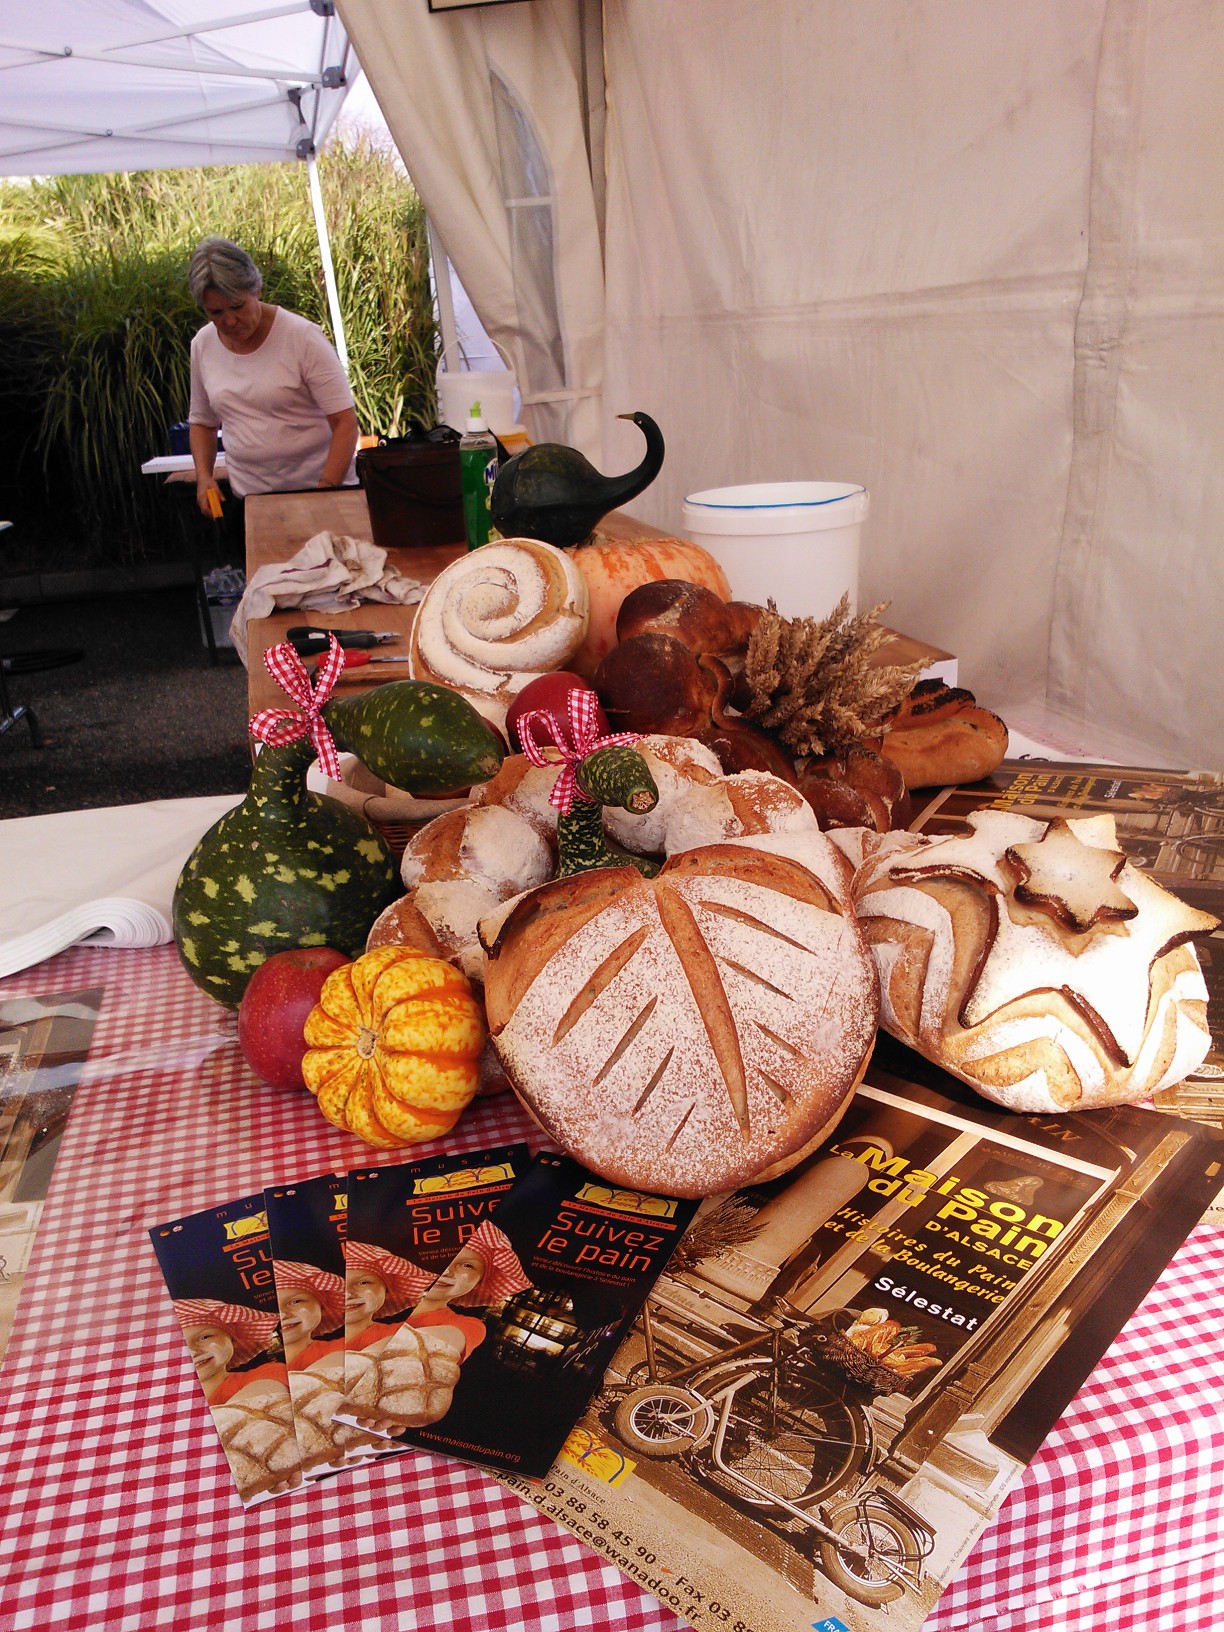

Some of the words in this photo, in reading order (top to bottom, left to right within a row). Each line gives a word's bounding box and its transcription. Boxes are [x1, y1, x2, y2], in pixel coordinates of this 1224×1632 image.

[987, 774, 1031, 809] Maison
[1025, 774, 1051, 792] Pain
[828, 1143, 855, 1160] La
[854, 1146, 1065, 1239] Maison
[413, 1227, 441, 1245] le
[550, 1211, 665, 1251] Suivez
[837, 1207, 927, 1252] Histoires
[932, 1250, 962, 1268] du
[867, 1177, 927, 1207] du
[936, 1200, 1048, 1258] Pain
[537, 1230, 568, 1254] le
[575, 1244, 651, 1272] pain
[824, 1219, 843, 1235] et
[845, 1228, 869, 1244] de
[871, 1239, 891, 1255] la
[893, 1248, 1005, 1304] Boulangerie
[925, 1221, 1033, 1271] D'ALSACE
[240, 1270, 273, 1290] le
[874, 1276, 979, 1332] Sélestat
[419, 1430, 522, 1463] www.maisondupain.org
[570, 1476, 606, 1504] d'Alsace
[545, 1482, 565, 1499] 03
[566, 1496, 587, 1514] 88
[588, 1512, 610, 1531] 58
[612, 1530, 633, 1547] 45
[635, 1546, 656, 1564] 90
[675, 1576, 706, 1603] Fax
[709, 1601, 730, 1621] 03
[733, 1620, 754, 1632] 8
